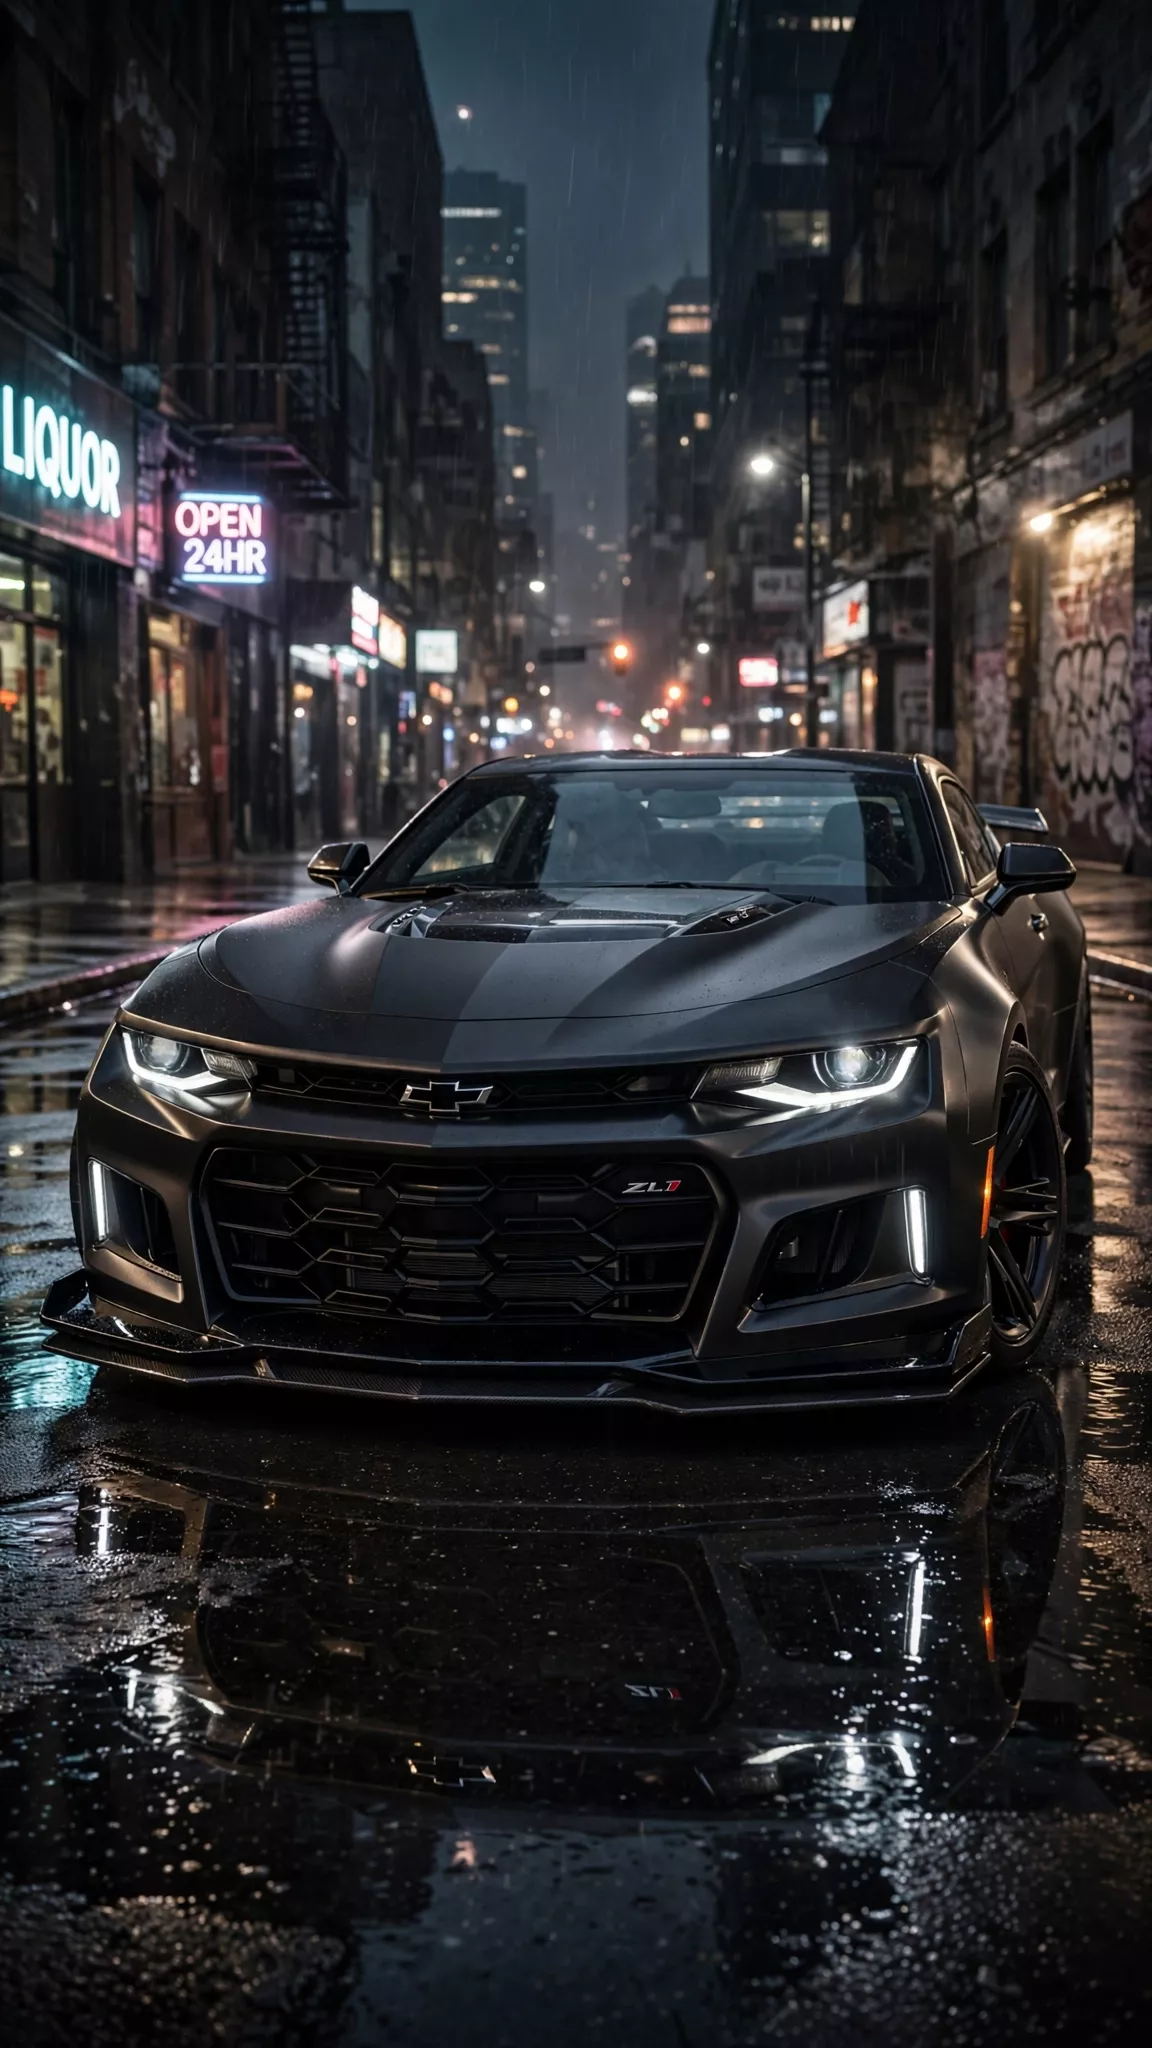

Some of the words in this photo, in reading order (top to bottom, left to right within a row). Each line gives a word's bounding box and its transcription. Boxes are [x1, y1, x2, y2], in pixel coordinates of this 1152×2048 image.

[2, 386, 121, 518] LIQUOR
[175, 502, 262, 537] OPEN
[184, 538, 266, 575] 24HR
[622, 1180, 682, 1194] ZL1
